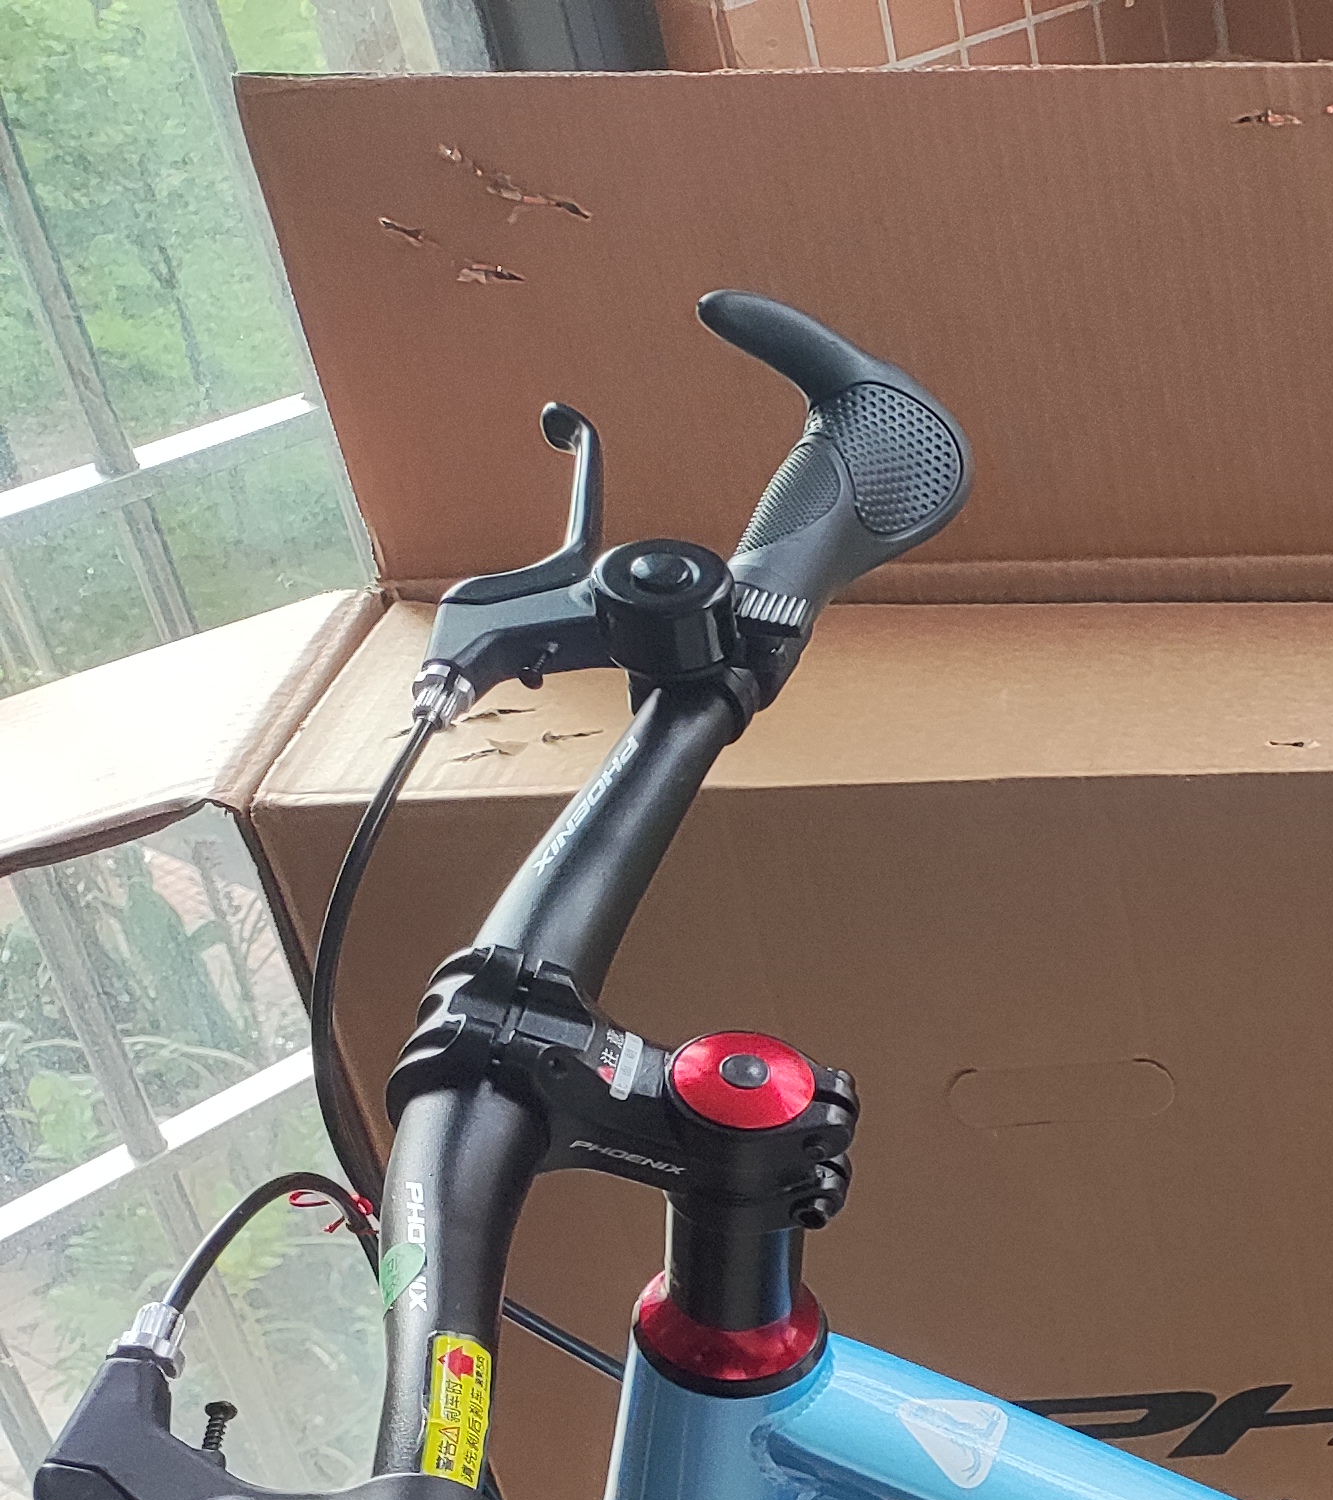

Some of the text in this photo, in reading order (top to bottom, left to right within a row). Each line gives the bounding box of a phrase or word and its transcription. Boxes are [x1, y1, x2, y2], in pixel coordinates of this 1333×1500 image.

[532, 735, 640, 877] PHOENIX
[569, 1139, 688, 1176] PHOENIX
[405, 1181, 428, 1312] PHOIX
